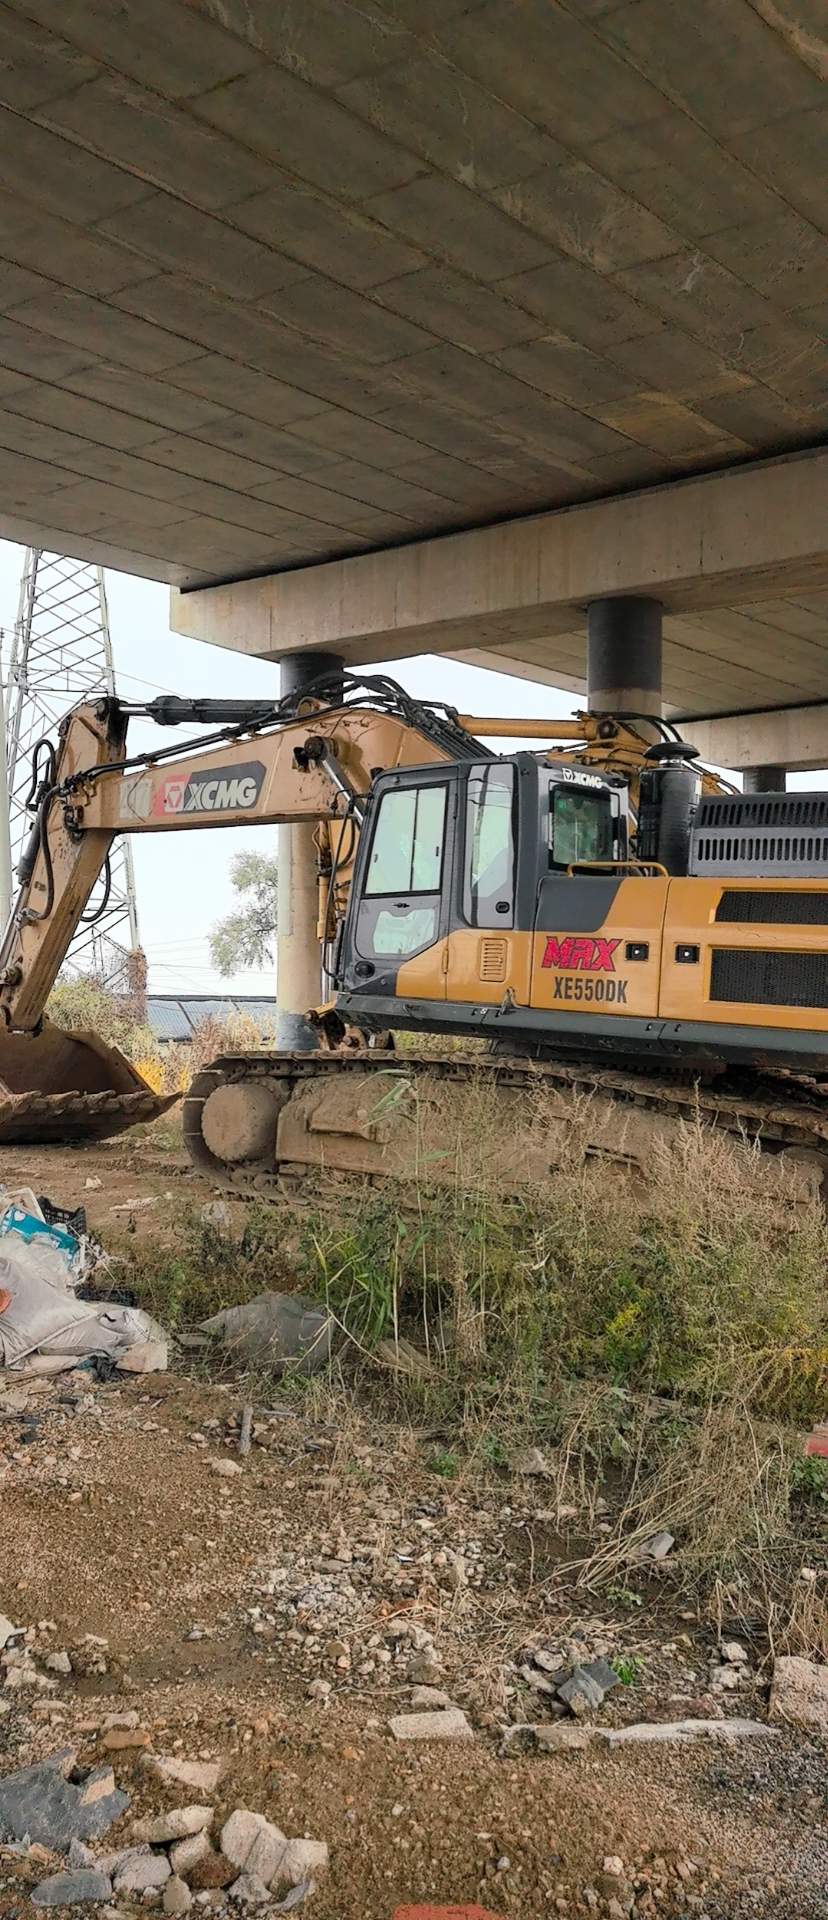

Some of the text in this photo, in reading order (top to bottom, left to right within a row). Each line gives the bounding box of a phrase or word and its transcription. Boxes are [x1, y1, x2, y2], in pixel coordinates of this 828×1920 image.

[183, 777, 257, 811] XCMG
[573, 771, 602, 789] XCMG
[541, 936, 623, 972] MAX
[553, 976, 628, 1003] XE550DK
